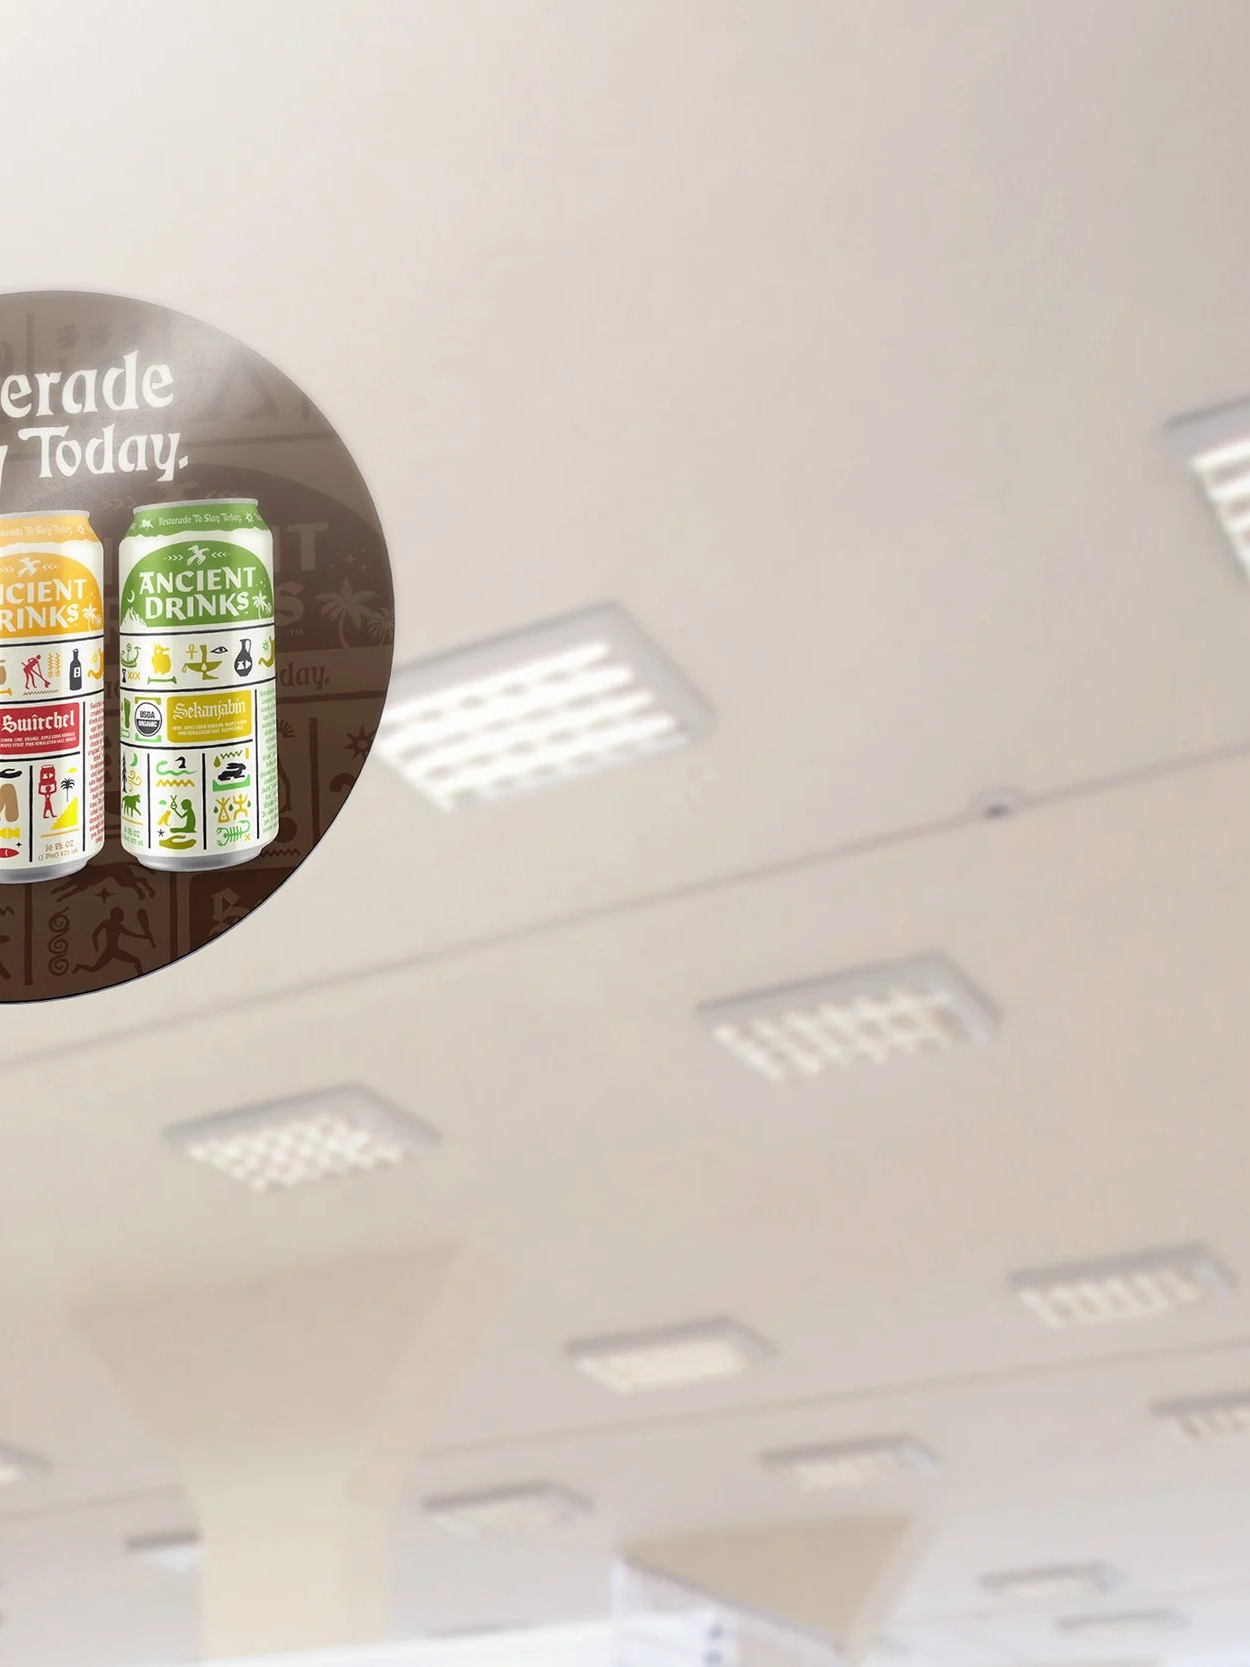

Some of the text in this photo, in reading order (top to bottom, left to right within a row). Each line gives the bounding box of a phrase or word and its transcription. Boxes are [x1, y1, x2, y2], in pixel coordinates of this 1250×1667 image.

[17, 424, 189, 482] Today.
[138, 566, 256, 595] ANCIENT
[145, 591, 250, 621] DRINKS
[279, 661, 330, 690] day.
[140, 710, 156, 719] USDA
[172, 698, 247, 721] Sekanjabin
